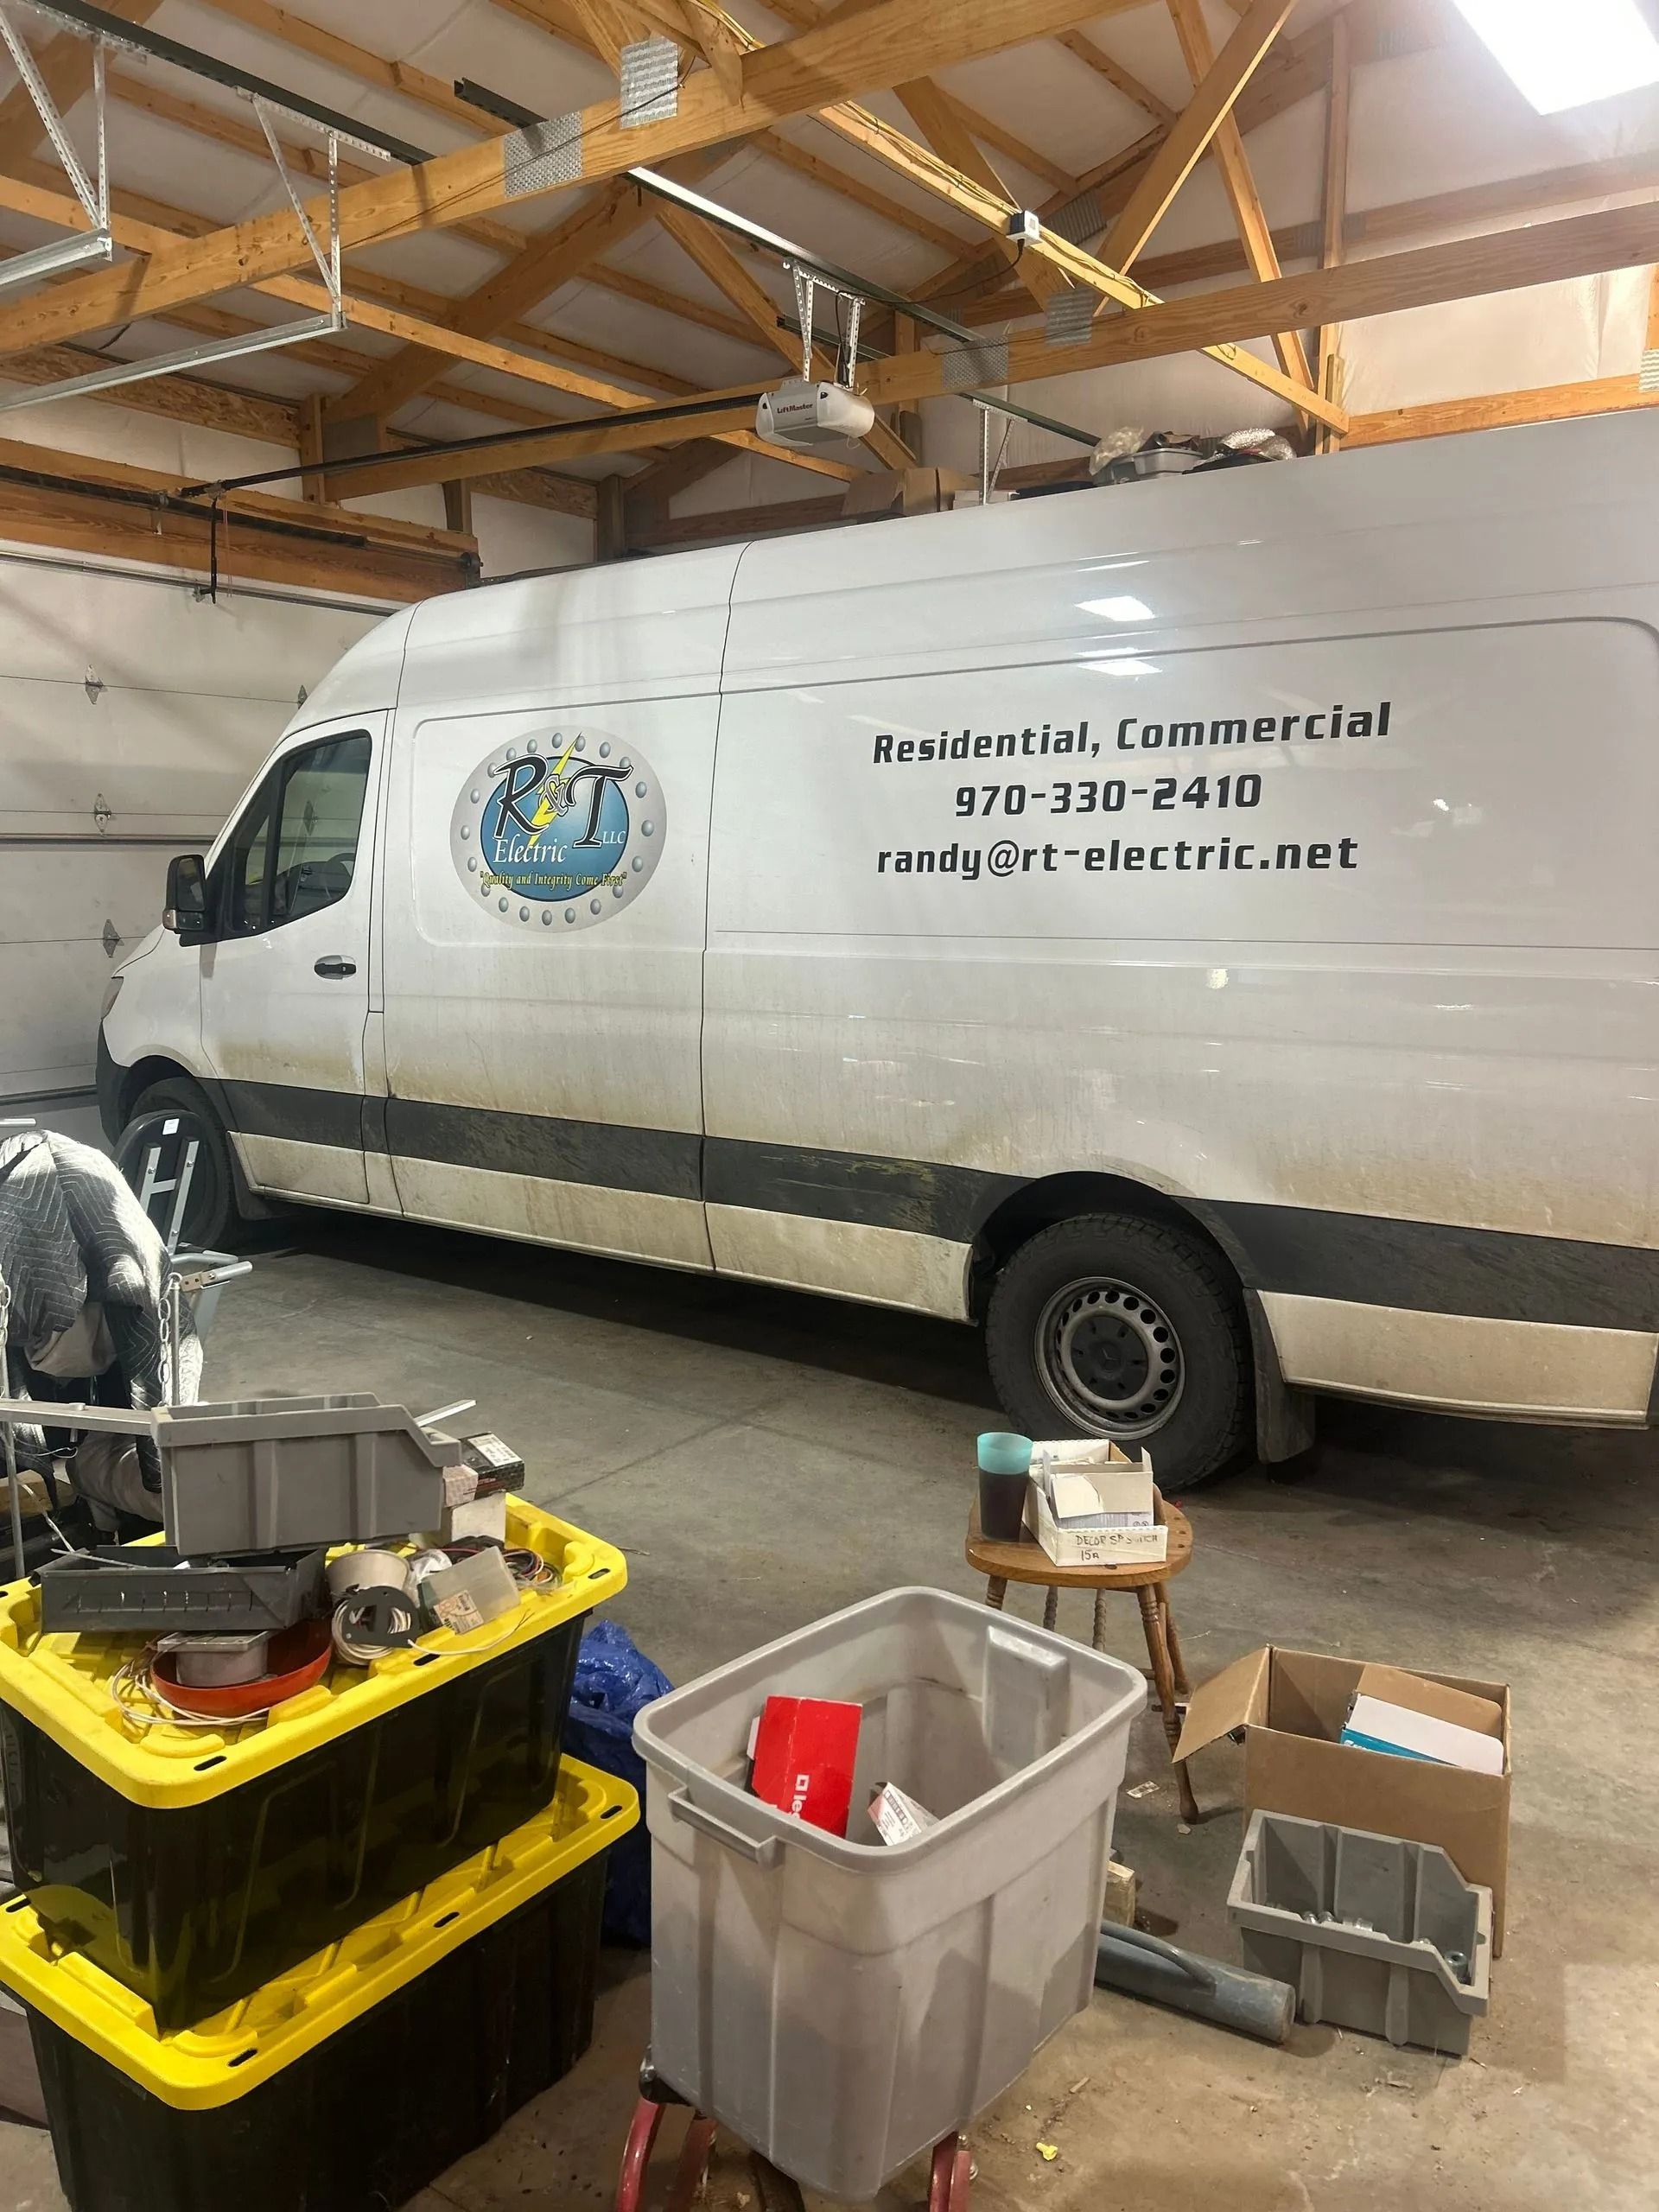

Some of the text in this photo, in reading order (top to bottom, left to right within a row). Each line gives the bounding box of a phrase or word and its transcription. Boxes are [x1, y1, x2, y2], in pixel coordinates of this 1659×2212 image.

[777, 404, 812, 413] LiftMaster
[873, 701, 1391, 764] Residential, Commercial
[494, 753, 634, 849] R&T
[956, 773, 1262, 817] 970-330-2410
[493, 834, 568, 863] Electric
[602, 830, 626, 844] LLC
[877, 836, 1358, 880] randy@rt-electric.net
[516, 871, 533, 885] and
[534, 873, 573, 891] Integrity
[575, 874, 598, 886] Come
